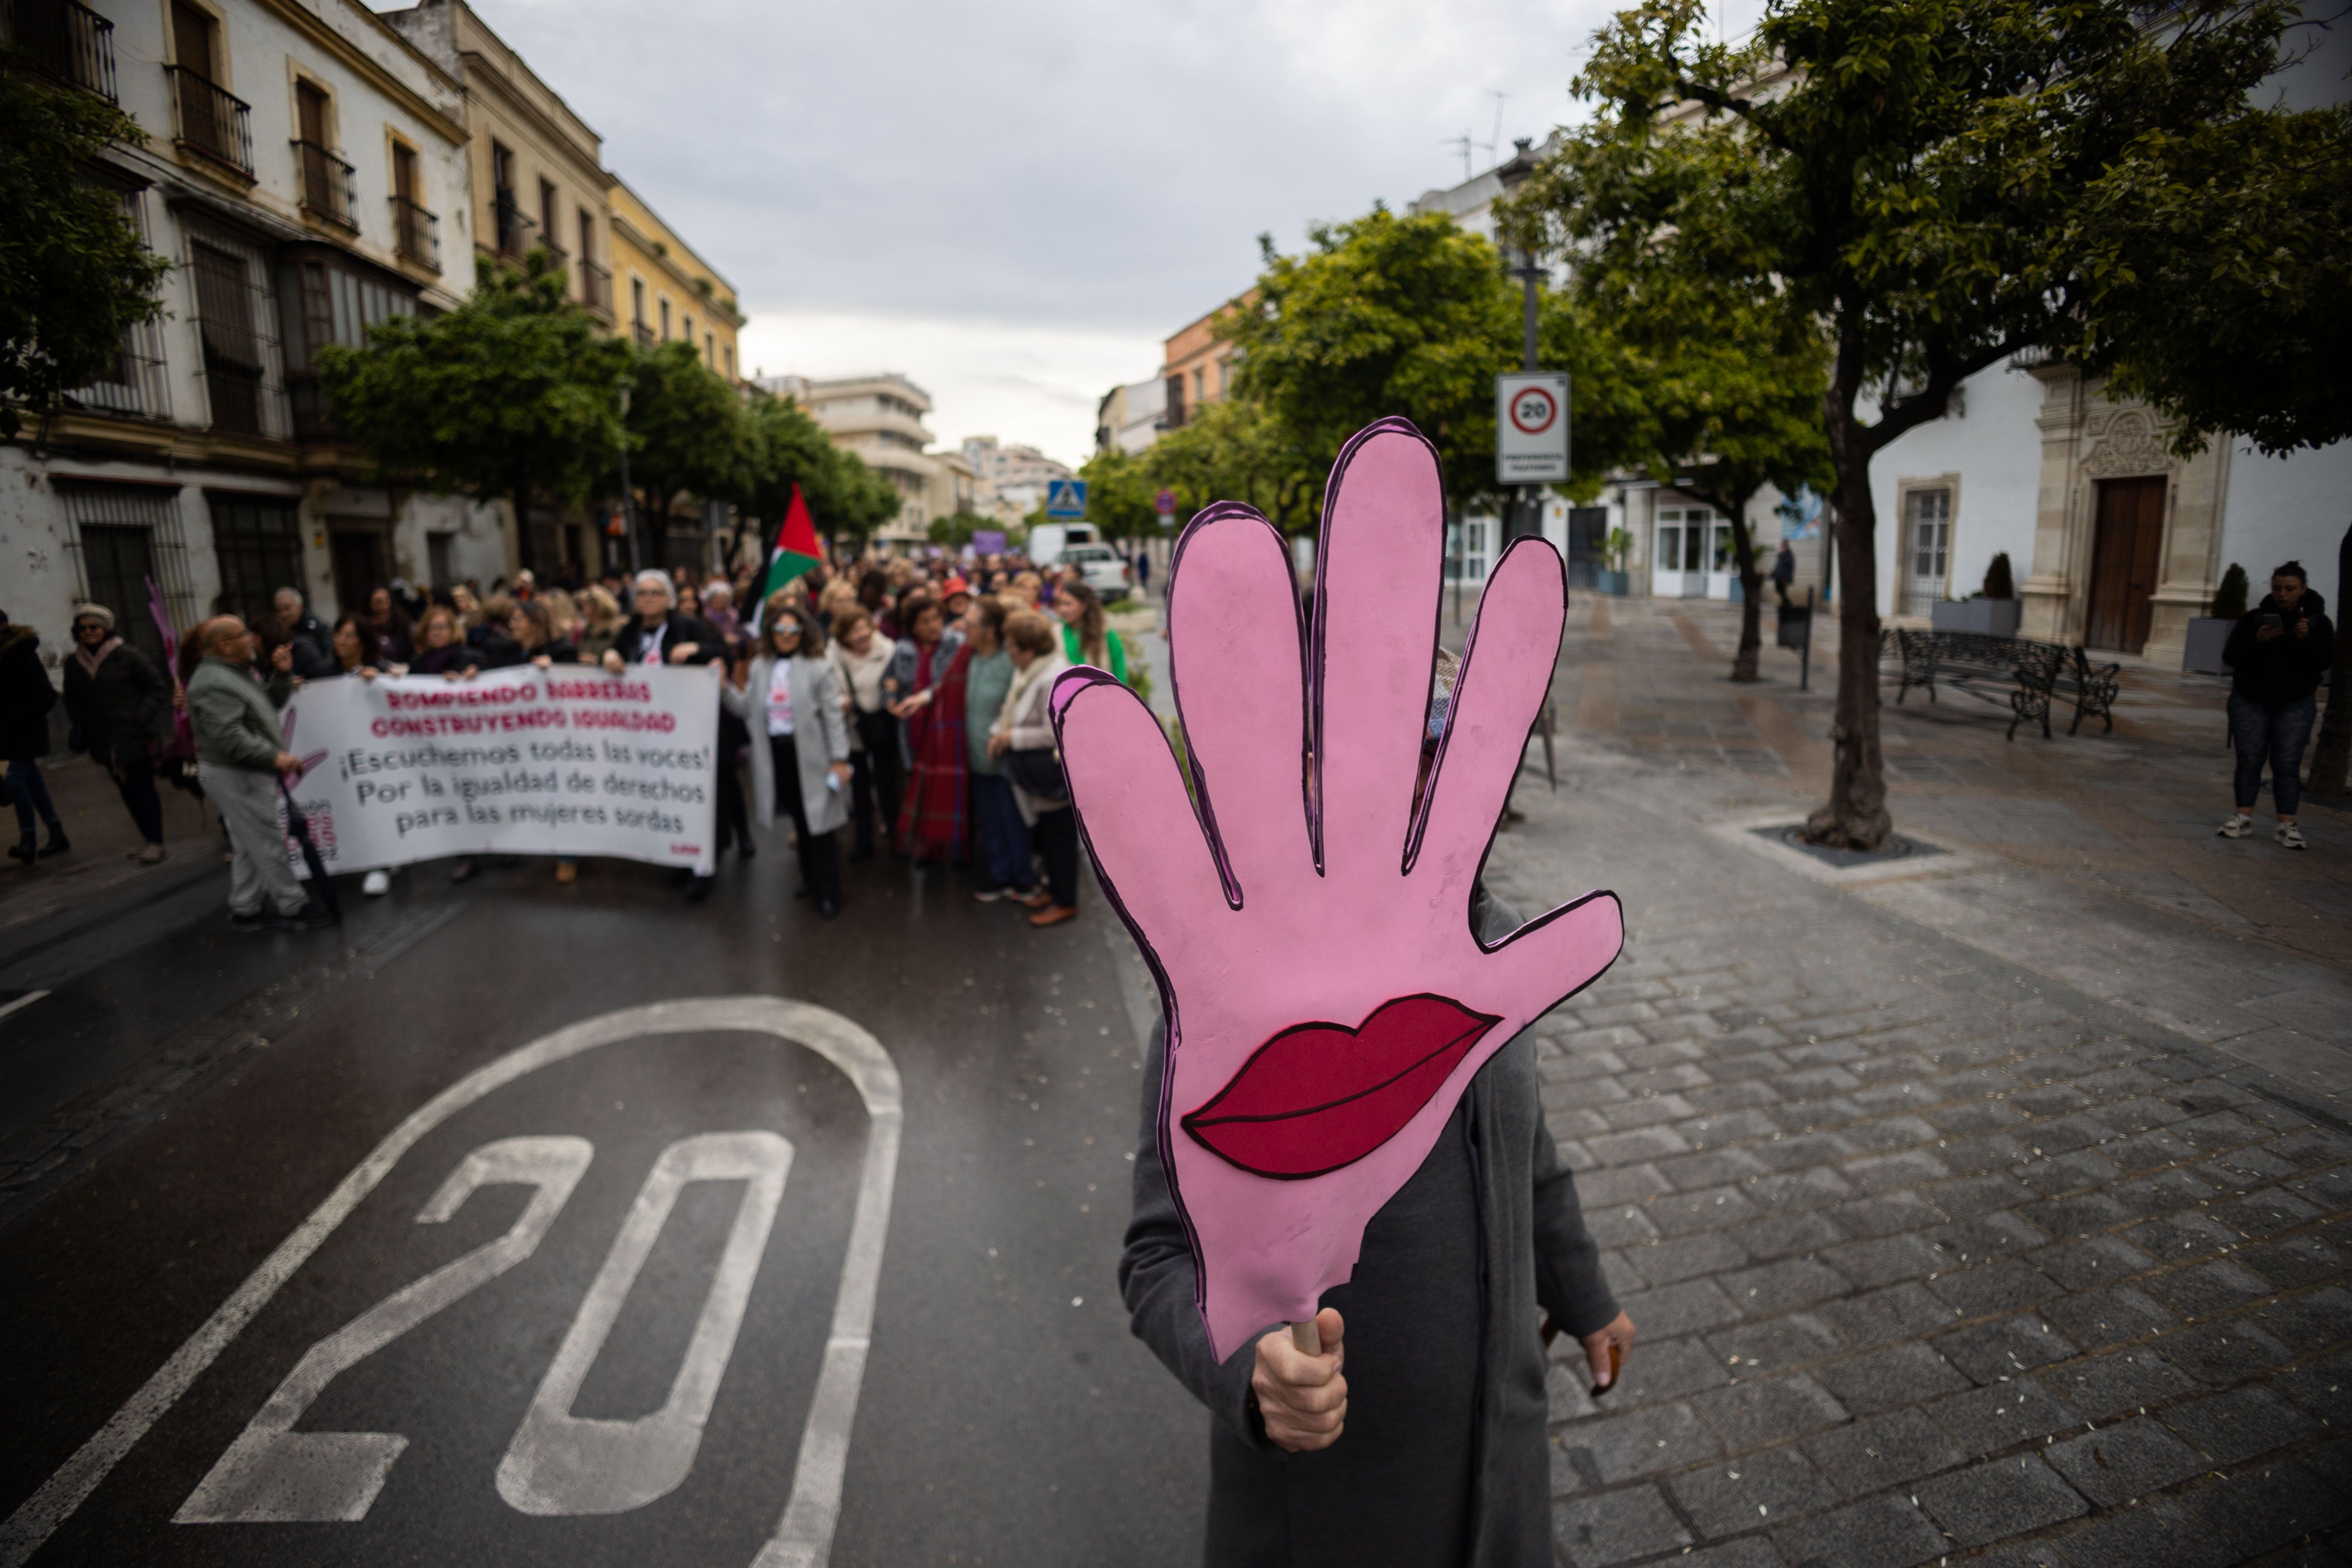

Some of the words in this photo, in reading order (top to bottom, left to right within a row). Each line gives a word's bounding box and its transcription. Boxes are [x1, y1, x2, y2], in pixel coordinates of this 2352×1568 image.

[1522, 401, 1546, 419] 20
[386, 683, 537, 710] ROMPIENDO
[546, 678, 651, 703] BARRERAS
[371, 708, 567, 738] CONSTRUYENDO
[573, 710, 676, 735] IGUALDAD
[340, 742, 520, 781] ¡Escuchemos
[530, 736, 596, 762] todas
[603, 736, 632, 764] las
[637, 744, 710, 771] voces!
[357, 779, 411, 806] Por
[420, 773, 444, 797] la
[452, 769, 557, 802] igualdad
[567, 769, 595, 794] de
[603, 771, 704, 804] derechos
[396, 806, 458, 838] para
[466, 802, 502, 824] las
[510, 799, 607, 829] mujeres
[614, 806, 684, 834] sordas
[170, 1130, 795, 1522] 20
